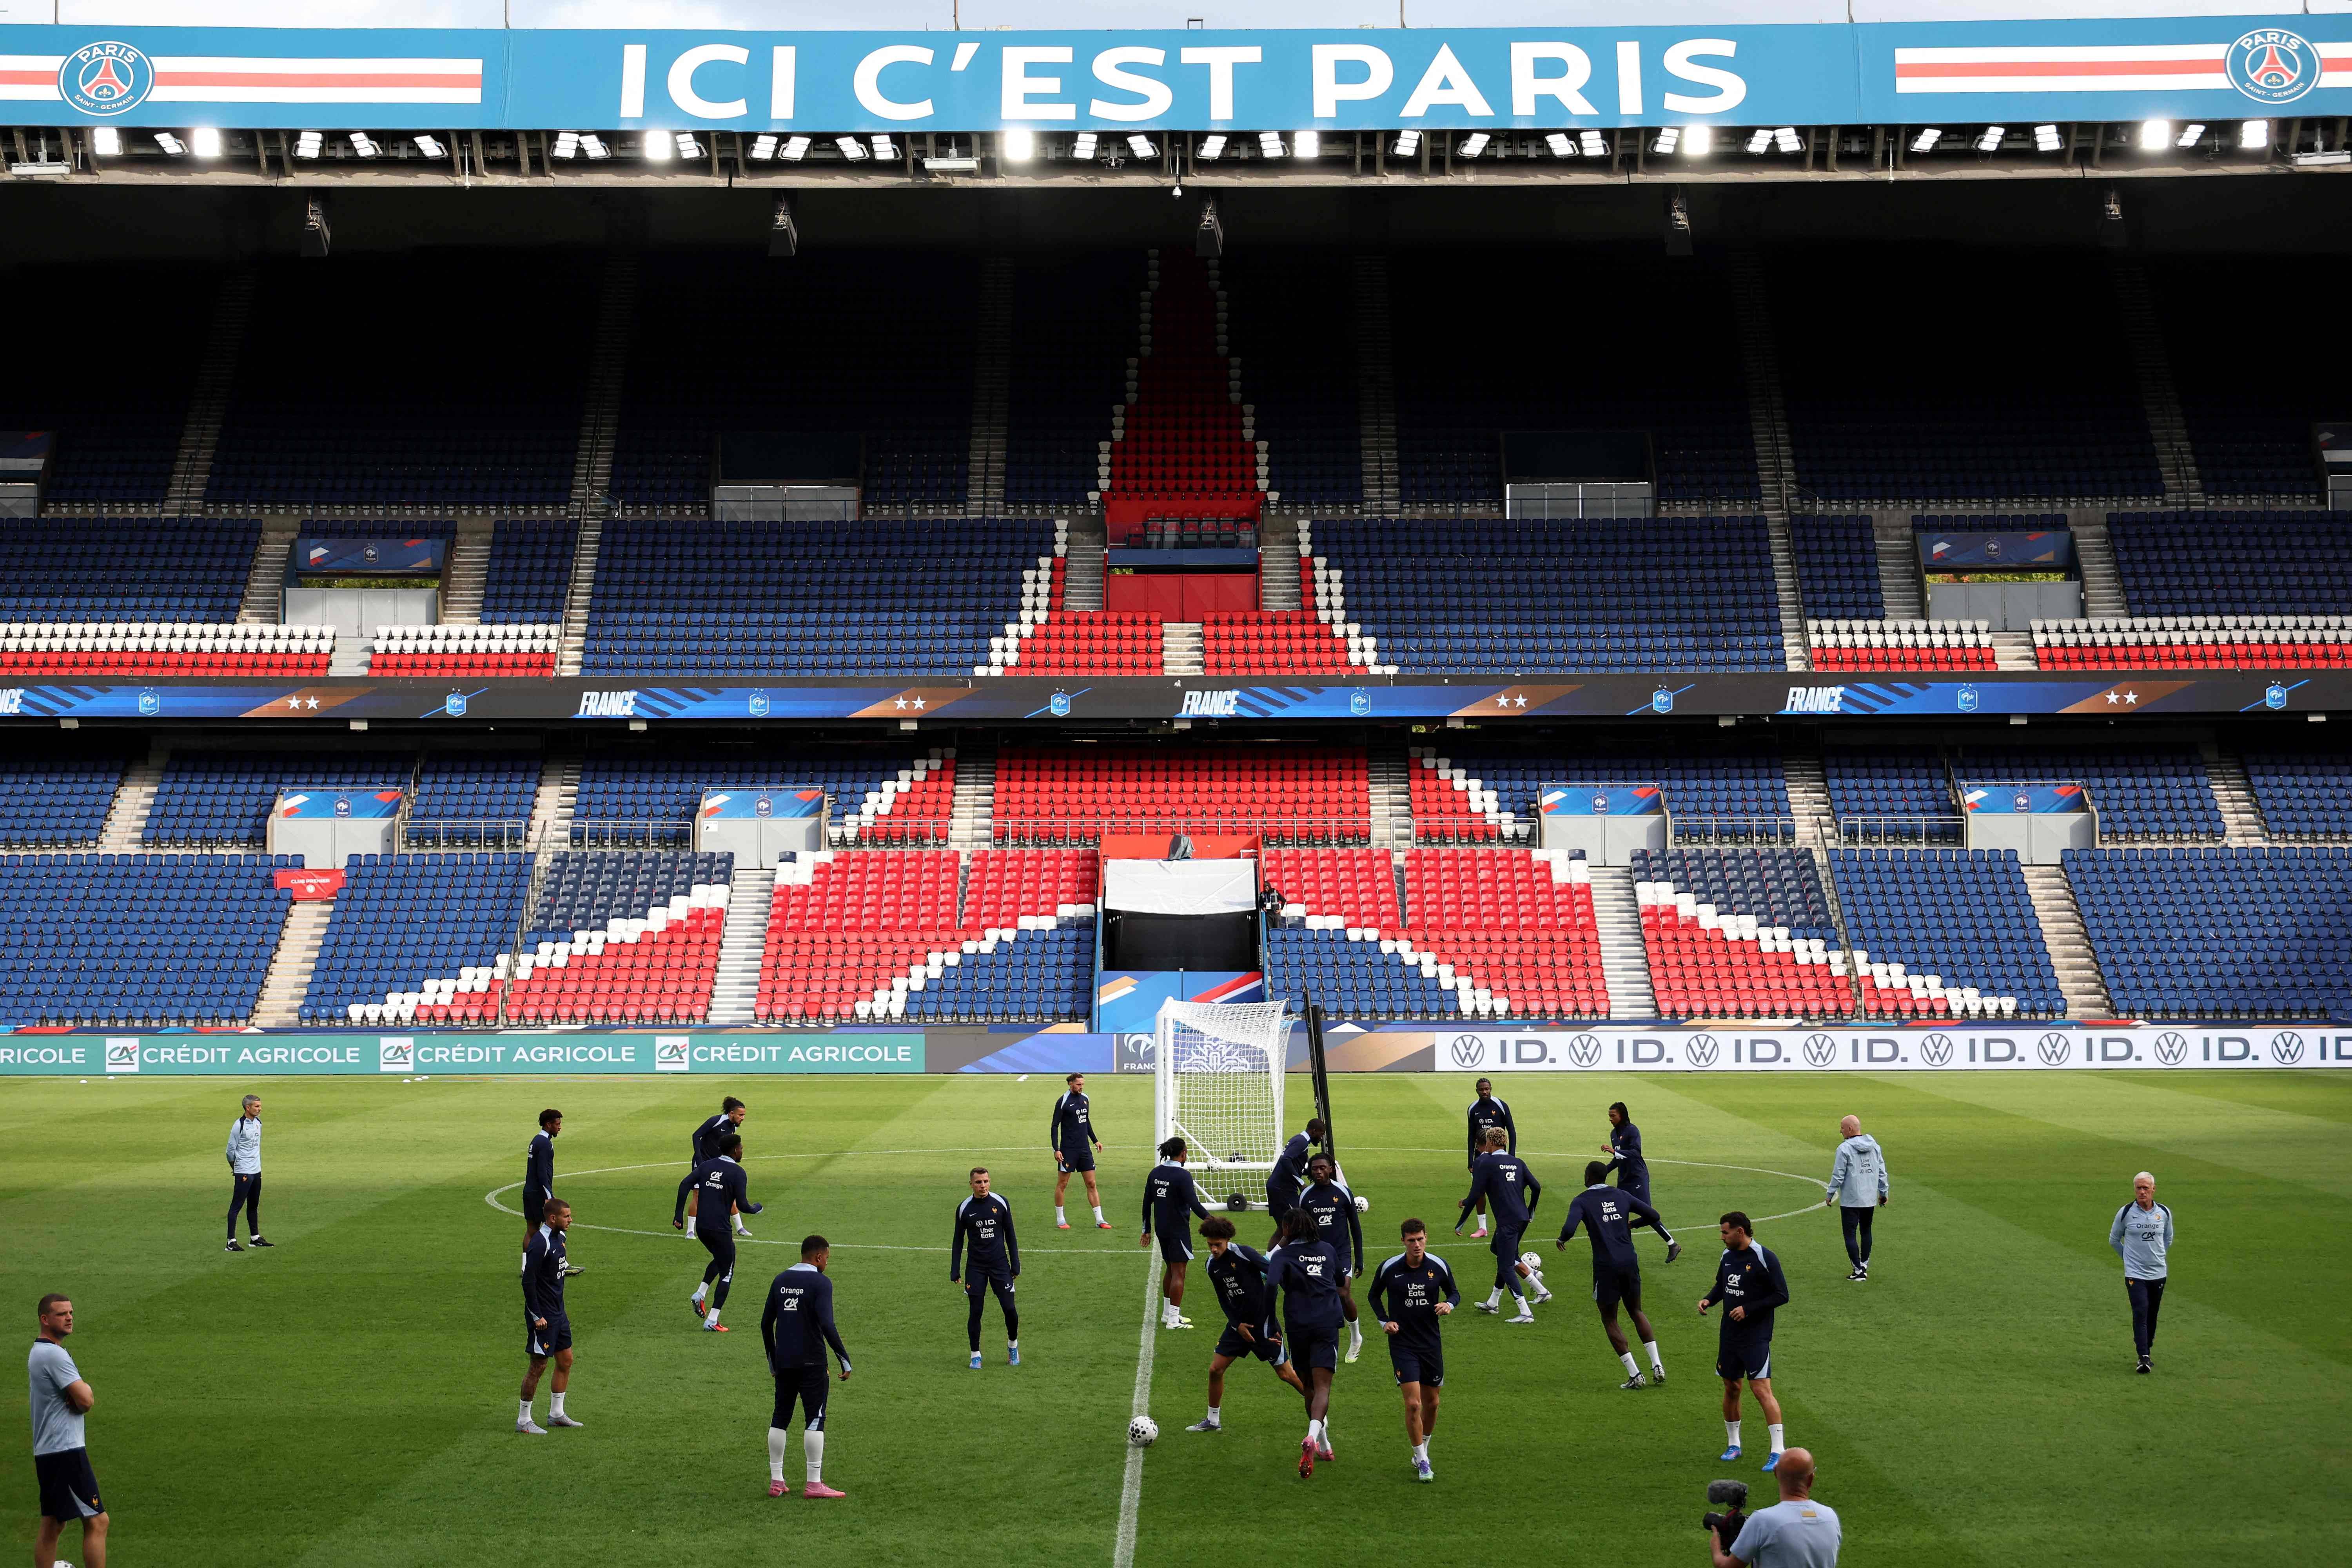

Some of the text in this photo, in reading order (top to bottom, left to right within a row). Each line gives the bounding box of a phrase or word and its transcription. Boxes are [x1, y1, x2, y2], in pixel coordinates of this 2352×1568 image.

[2239, 32, 2301, 50] PARIS
[78, 45, 138, 63] PARIS
[620, 38, 1747, 121] ICI C'EST PARIS
[579, 691, 638, 715] FRANCE
[1181, 691, 1240, 715] FRANCE
[1786, 687, 1845, 711] FRANCE
[0, 1048, 85, 1063] RICOLE
[143, 1044, 230, 1063] CRÉDIT
[238, 1047, 359, 1063] AGRICOLE
[417, 1044, 506, 1062] CRÉDIT
[512, 1046, 635, 1062] AGRICOLE
[693, 1043, 781, 1062] CRÉDIT
[788, 1045, 911, 1062] AGRICOLE
[1500, 1040, 1556, 1063] ID.
[1617, 1039, 1674, 1063] ID.
[1735, 1039, 1791, 1062] ID.
[1852, 1039, 1908, 1062] ID.
[1969, 1038, 2025, 1062] ID.
[2086, 1038, 2142, 1061] ID.
[2203, 1037, 2259, 1060] ID.
[780, 1287, 804, 1295] Orange
[1725, 1286, 1744, 1296] Orange
